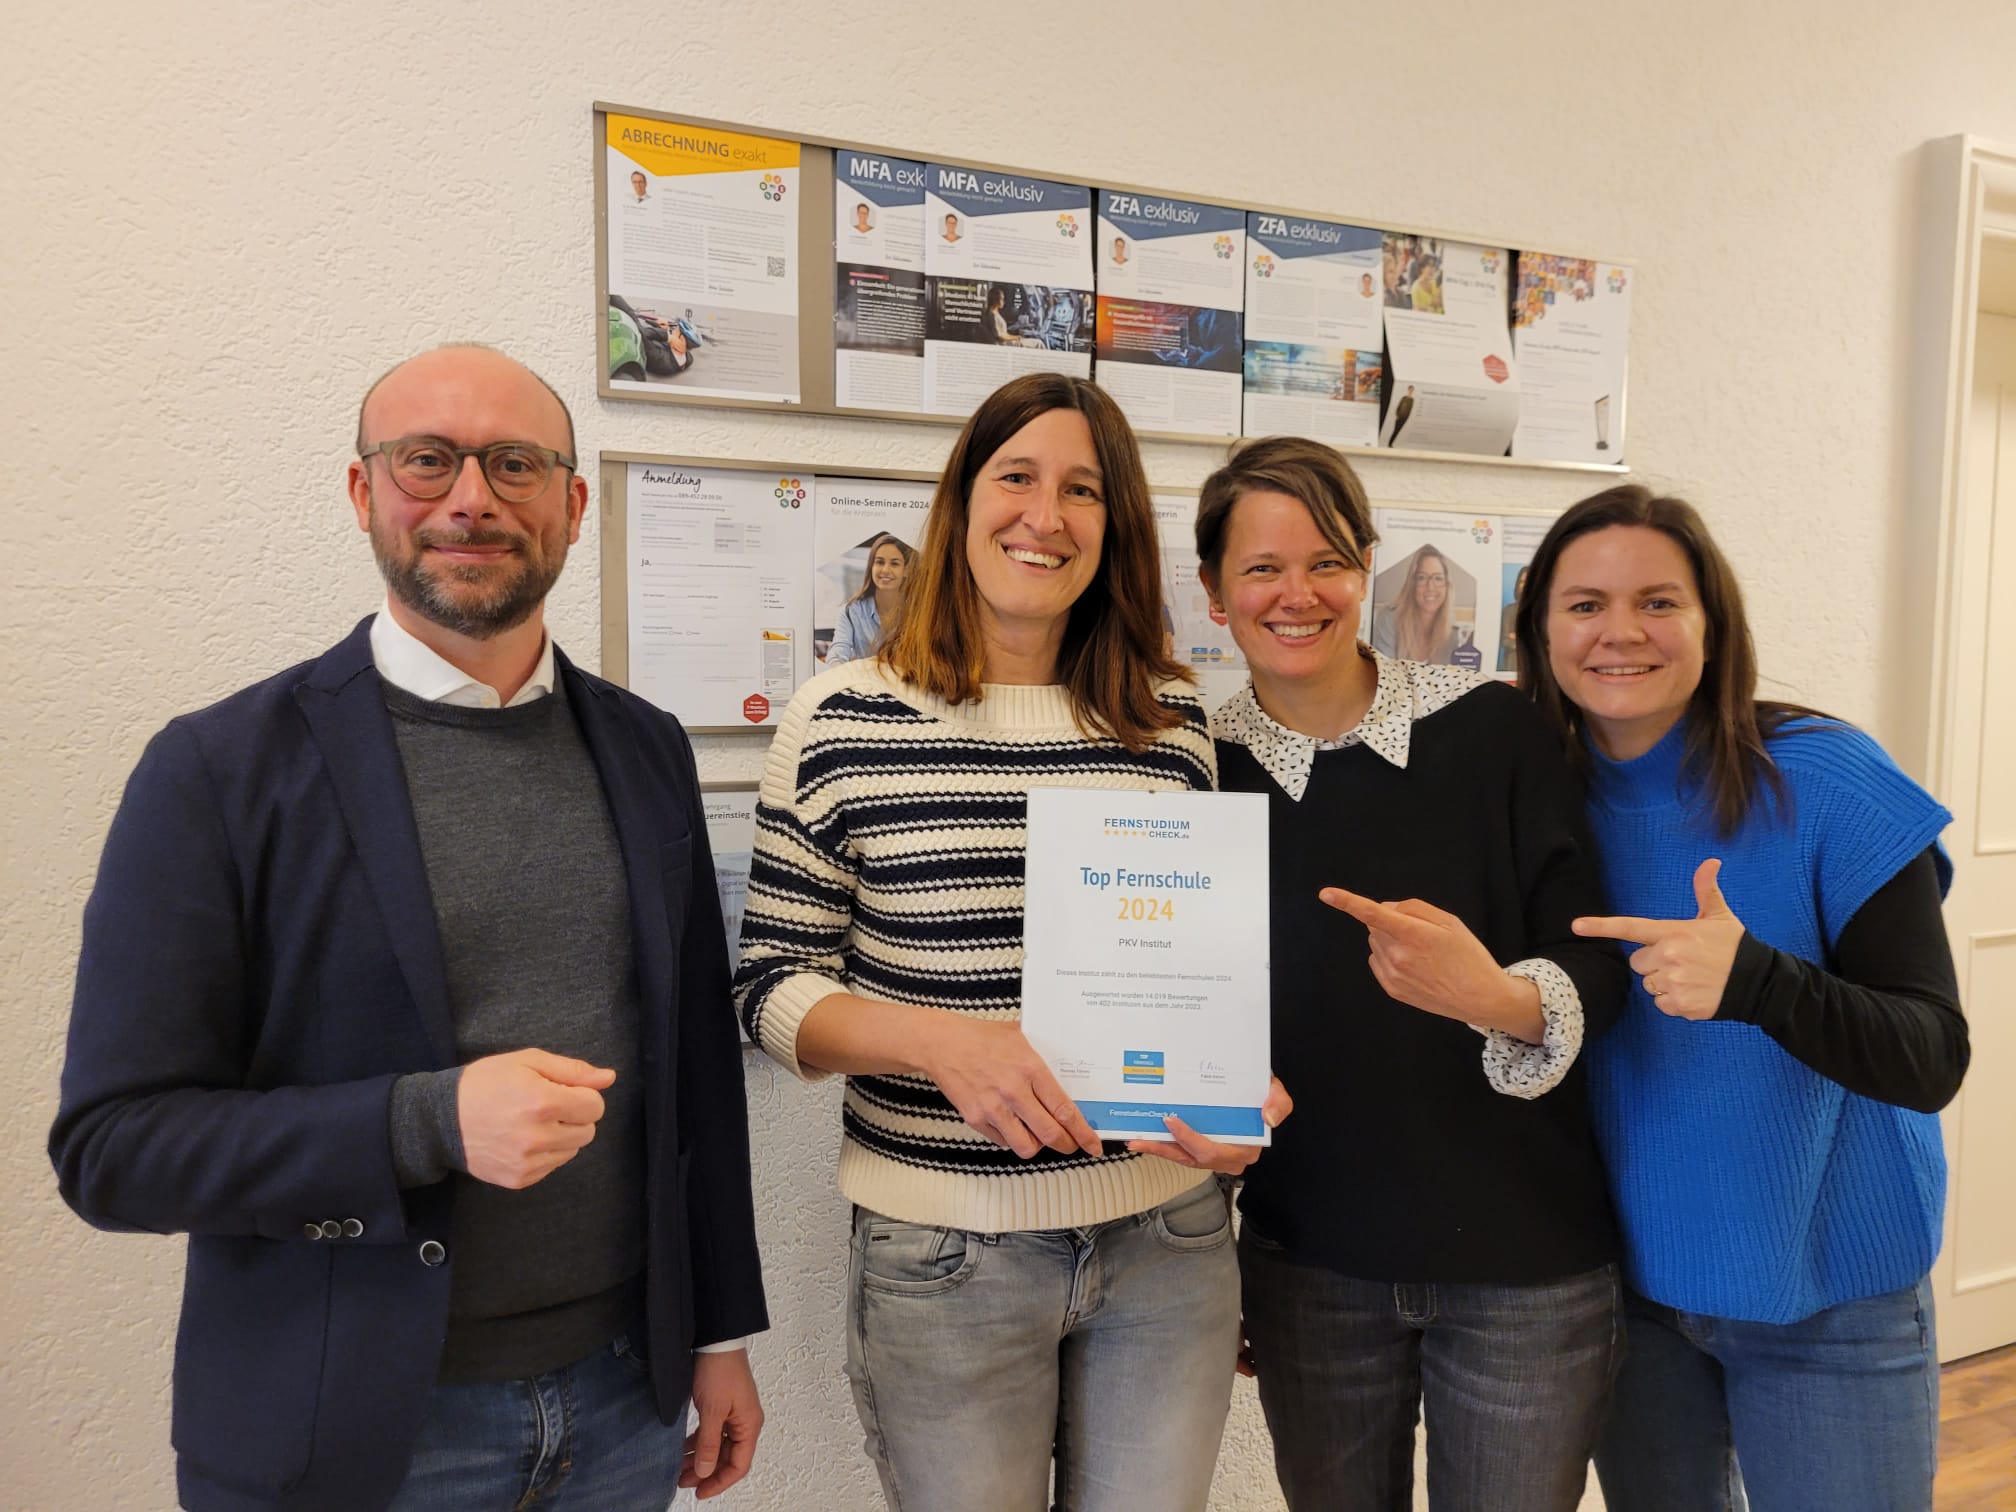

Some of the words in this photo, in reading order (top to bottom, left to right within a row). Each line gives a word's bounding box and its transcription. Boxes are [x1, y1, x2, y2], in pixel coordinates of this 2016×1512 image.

[622, 128, 729, 157] ABRECHNUNG
[733, 148, 767, 163] exakt
[850, 158, 892, 182] MFA
[939, 170, 979, 193] MFA
[983, 179, 1044, 203] exklusiv
[1109, 195, 1140, 216] ZFA
[1144, 203, 1200, 225] exklusiv
[1258, 217, 1288, 237] ZFA
[1290, 223, 1341, 244] exklusiv
[642, 469, 702, 493] Anmeldung
[831, 497, 907, 509] Online-Seminare
[909, 500, 929, 509] 2024
[1104, 818, 1190, 830] FERNSTUDIUM
[1149, 831, 1190, 839] CHECK.de
[1080, 867, 1110, 890] Top
[1117, 868, 1211, 890] Fernschule
[1118, 897, 1174, 921] 2024
[1118, 938, 1138, 948] PKV
[1140, 939, 1172, 949] Institut
[1056, 968, 1077, 976] Dieses
[1079, 969, 1100, 977] Institut
[1127, 971, 1137, 979] den
[1177, 973, 1215, 981] Fernschulen
[1081, 990, 1120, 999] Ausgewertet
[1167, 993, 1208, 1002] Bewertungen
